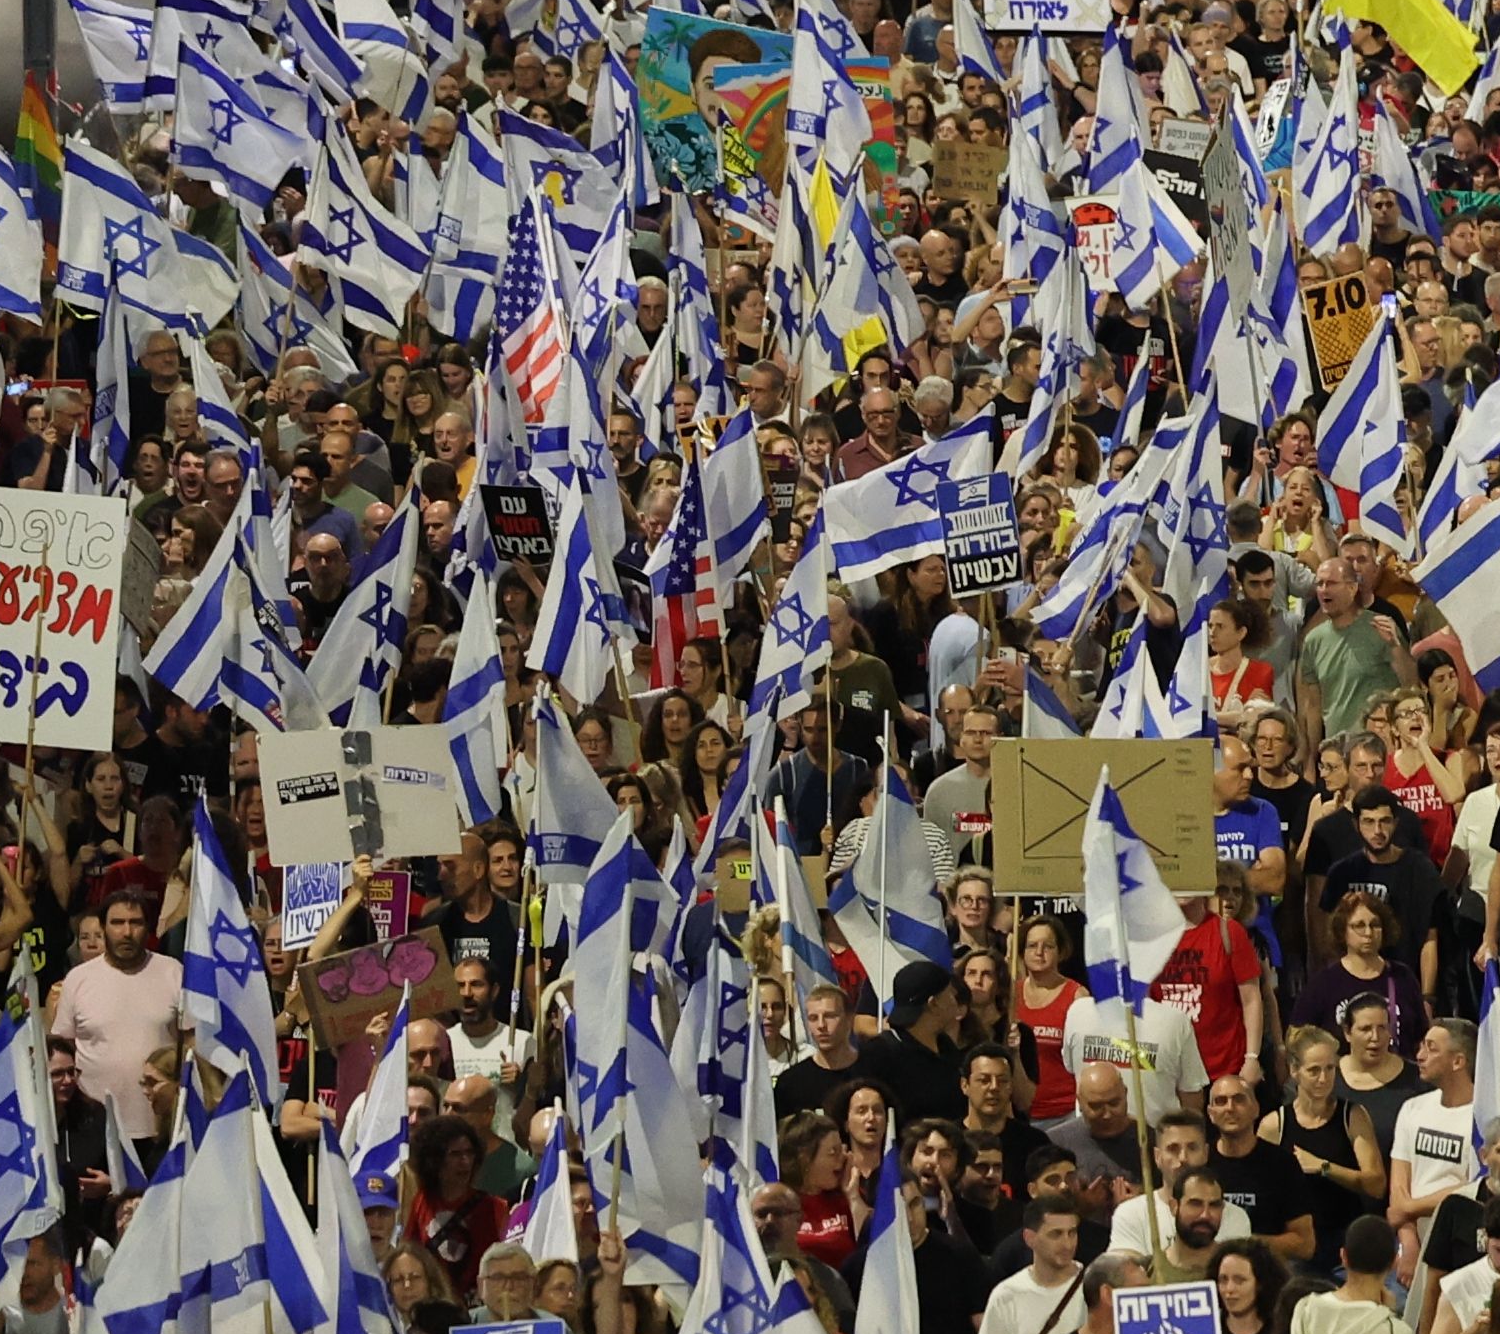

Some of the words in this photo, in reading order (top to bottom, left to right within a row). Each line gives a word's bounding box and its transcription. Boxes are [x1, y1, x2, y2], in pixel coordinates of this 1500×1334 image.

[1306, 278, 1365, 321] 7.10
[499, 495, 526, 515] עם
[947, 527, 1018, 558] בחירות
[386, 768, 428, 782] בחירות
[1217, 831, 1246, 843] להיות
[1118, 1294, 1211, 1324] בחירות
